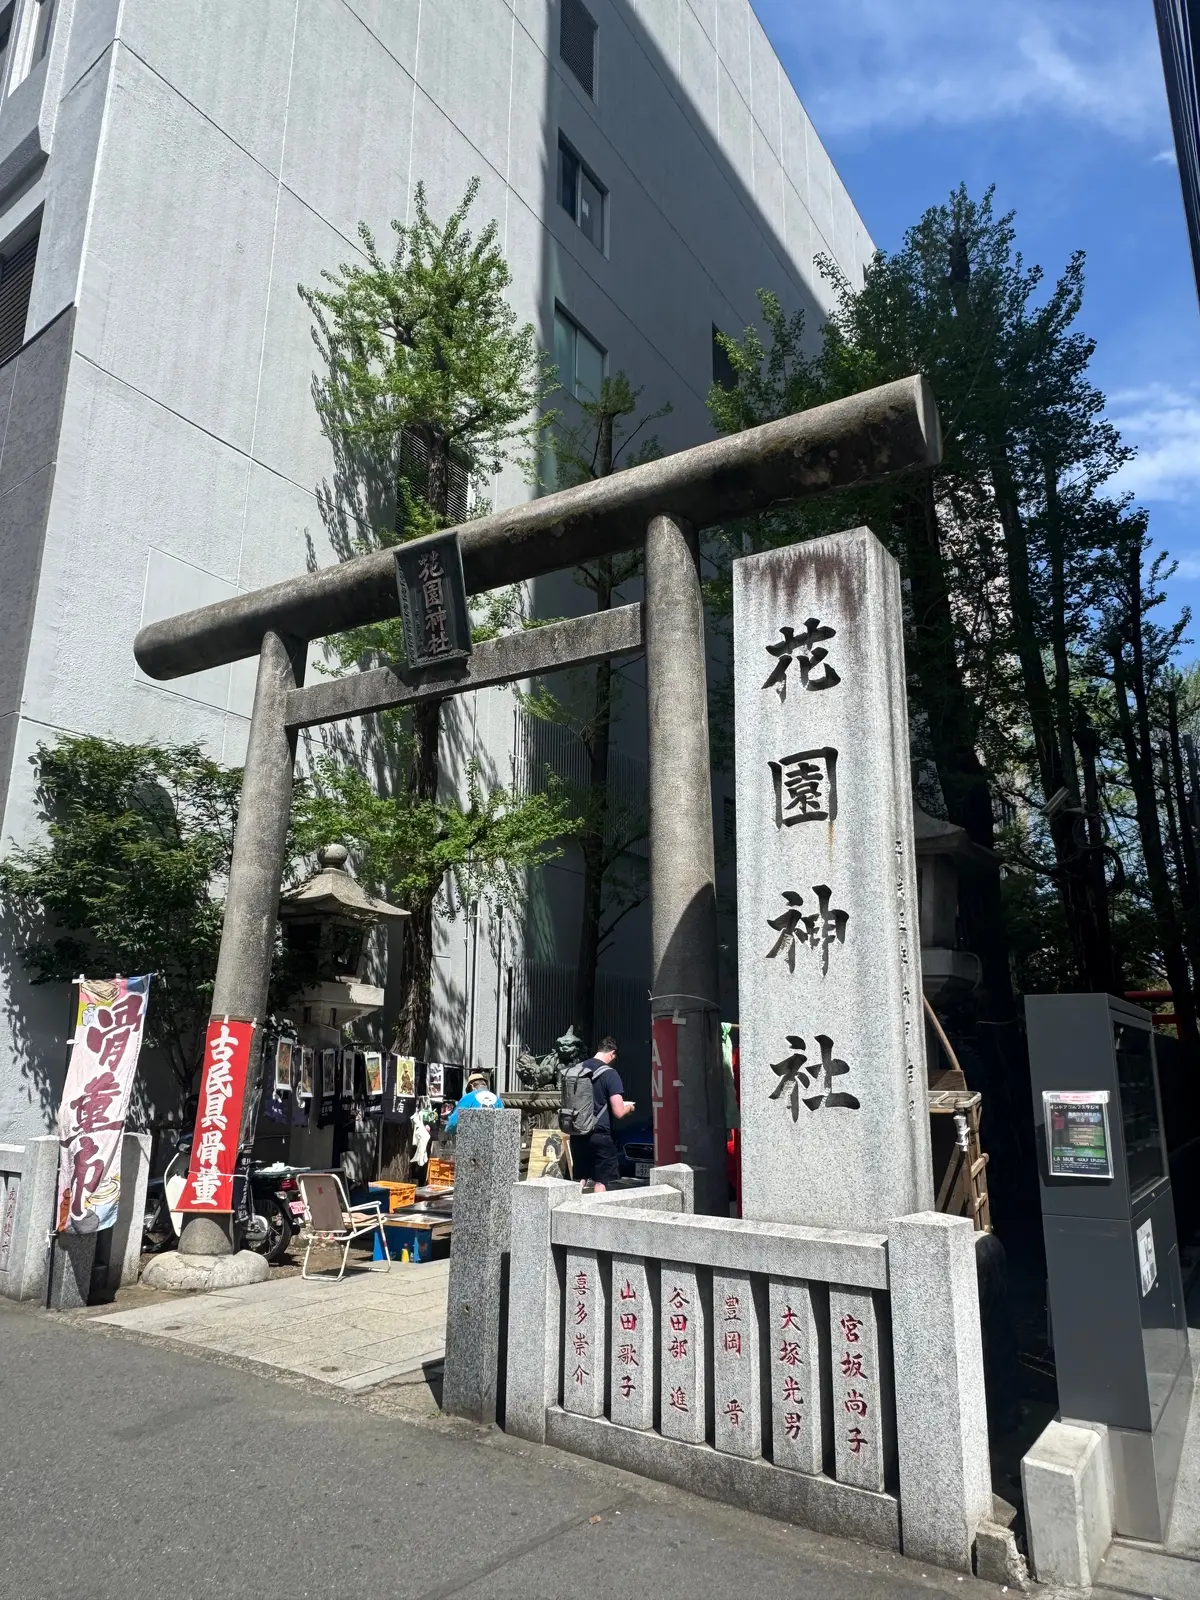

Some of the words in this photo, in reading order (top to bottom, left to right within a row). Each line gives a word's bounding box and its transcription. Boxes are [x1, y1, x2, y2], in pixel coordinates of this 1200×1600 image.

[418, 550, 452, 655] 花園神社
[760, 617, 860, 1122] 花園神社
[60, 994, 143, 1217] 骨董市
[572, 1270, 591, 1386] 喜多崇介
[617, 1278, 639, 1398] 山田歌子
[779, 1304, 804, 1440] 大塚光男
[840, 1313, 869, 1454] 宮坂尚子
